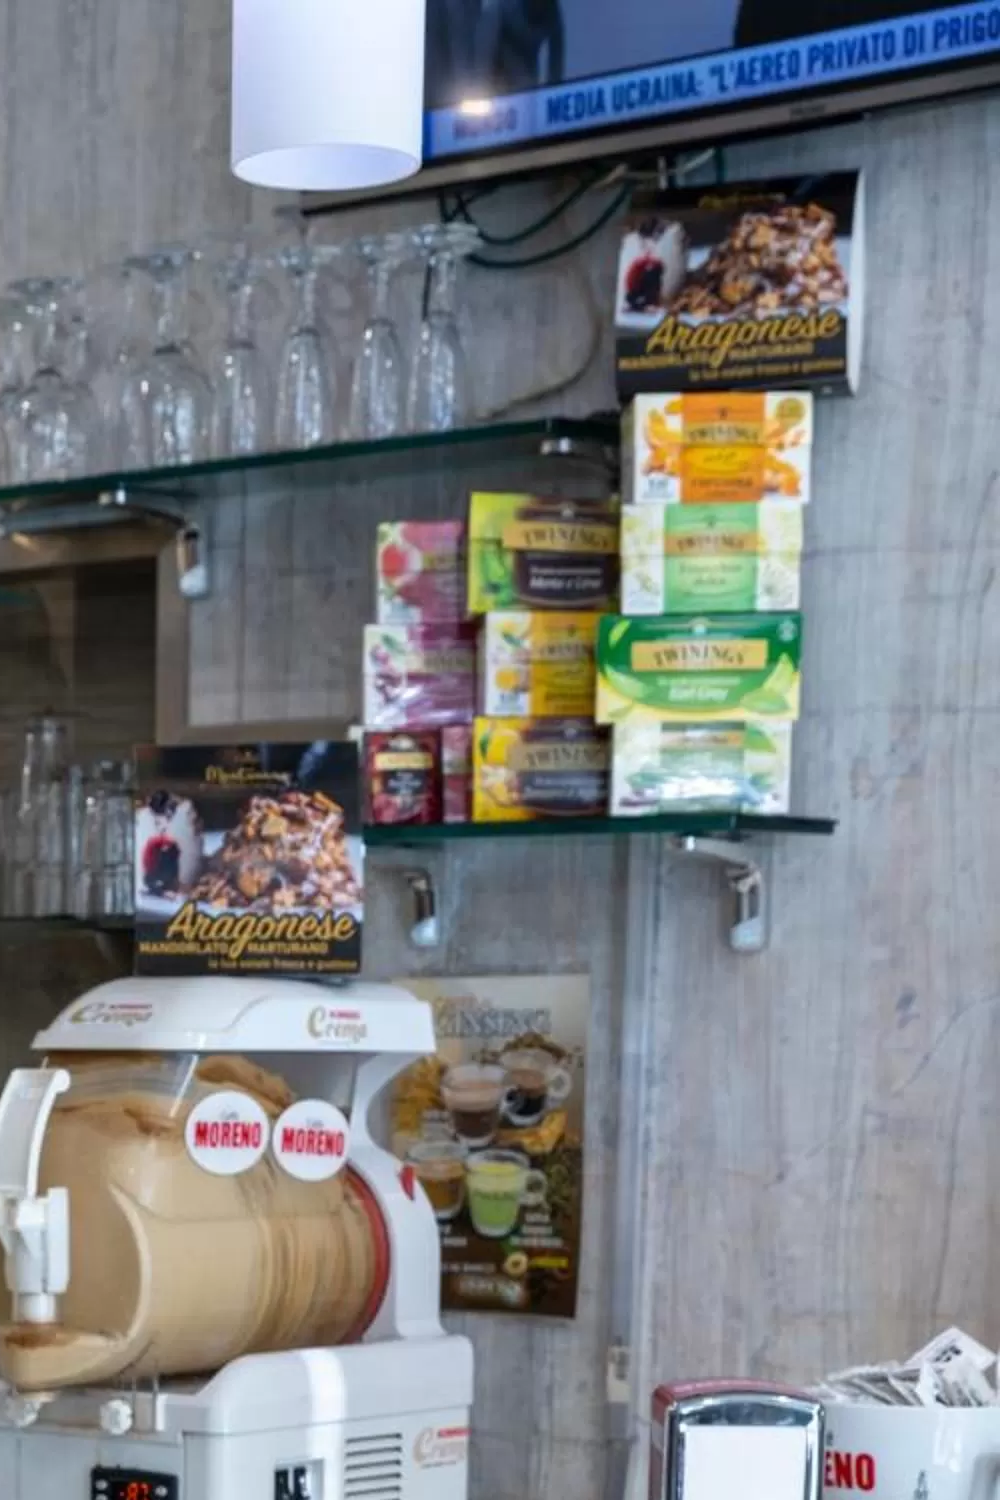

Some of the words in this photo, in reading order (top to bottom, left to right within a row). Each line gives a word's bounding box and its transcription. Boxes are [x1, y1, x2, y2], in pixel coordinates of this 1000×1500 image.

[546, 85, 605, 124] MEDIA
[807, 29, 896, 76] PRIVATO
[903, 19, 926, 57] DI
[647, 312, 841, 369] Aragonese
[166, 903, 356, 960] Aragonese
[194, 1120, 262, 1149] MORENO
[281, 1127, 345, 1157] MORENO
